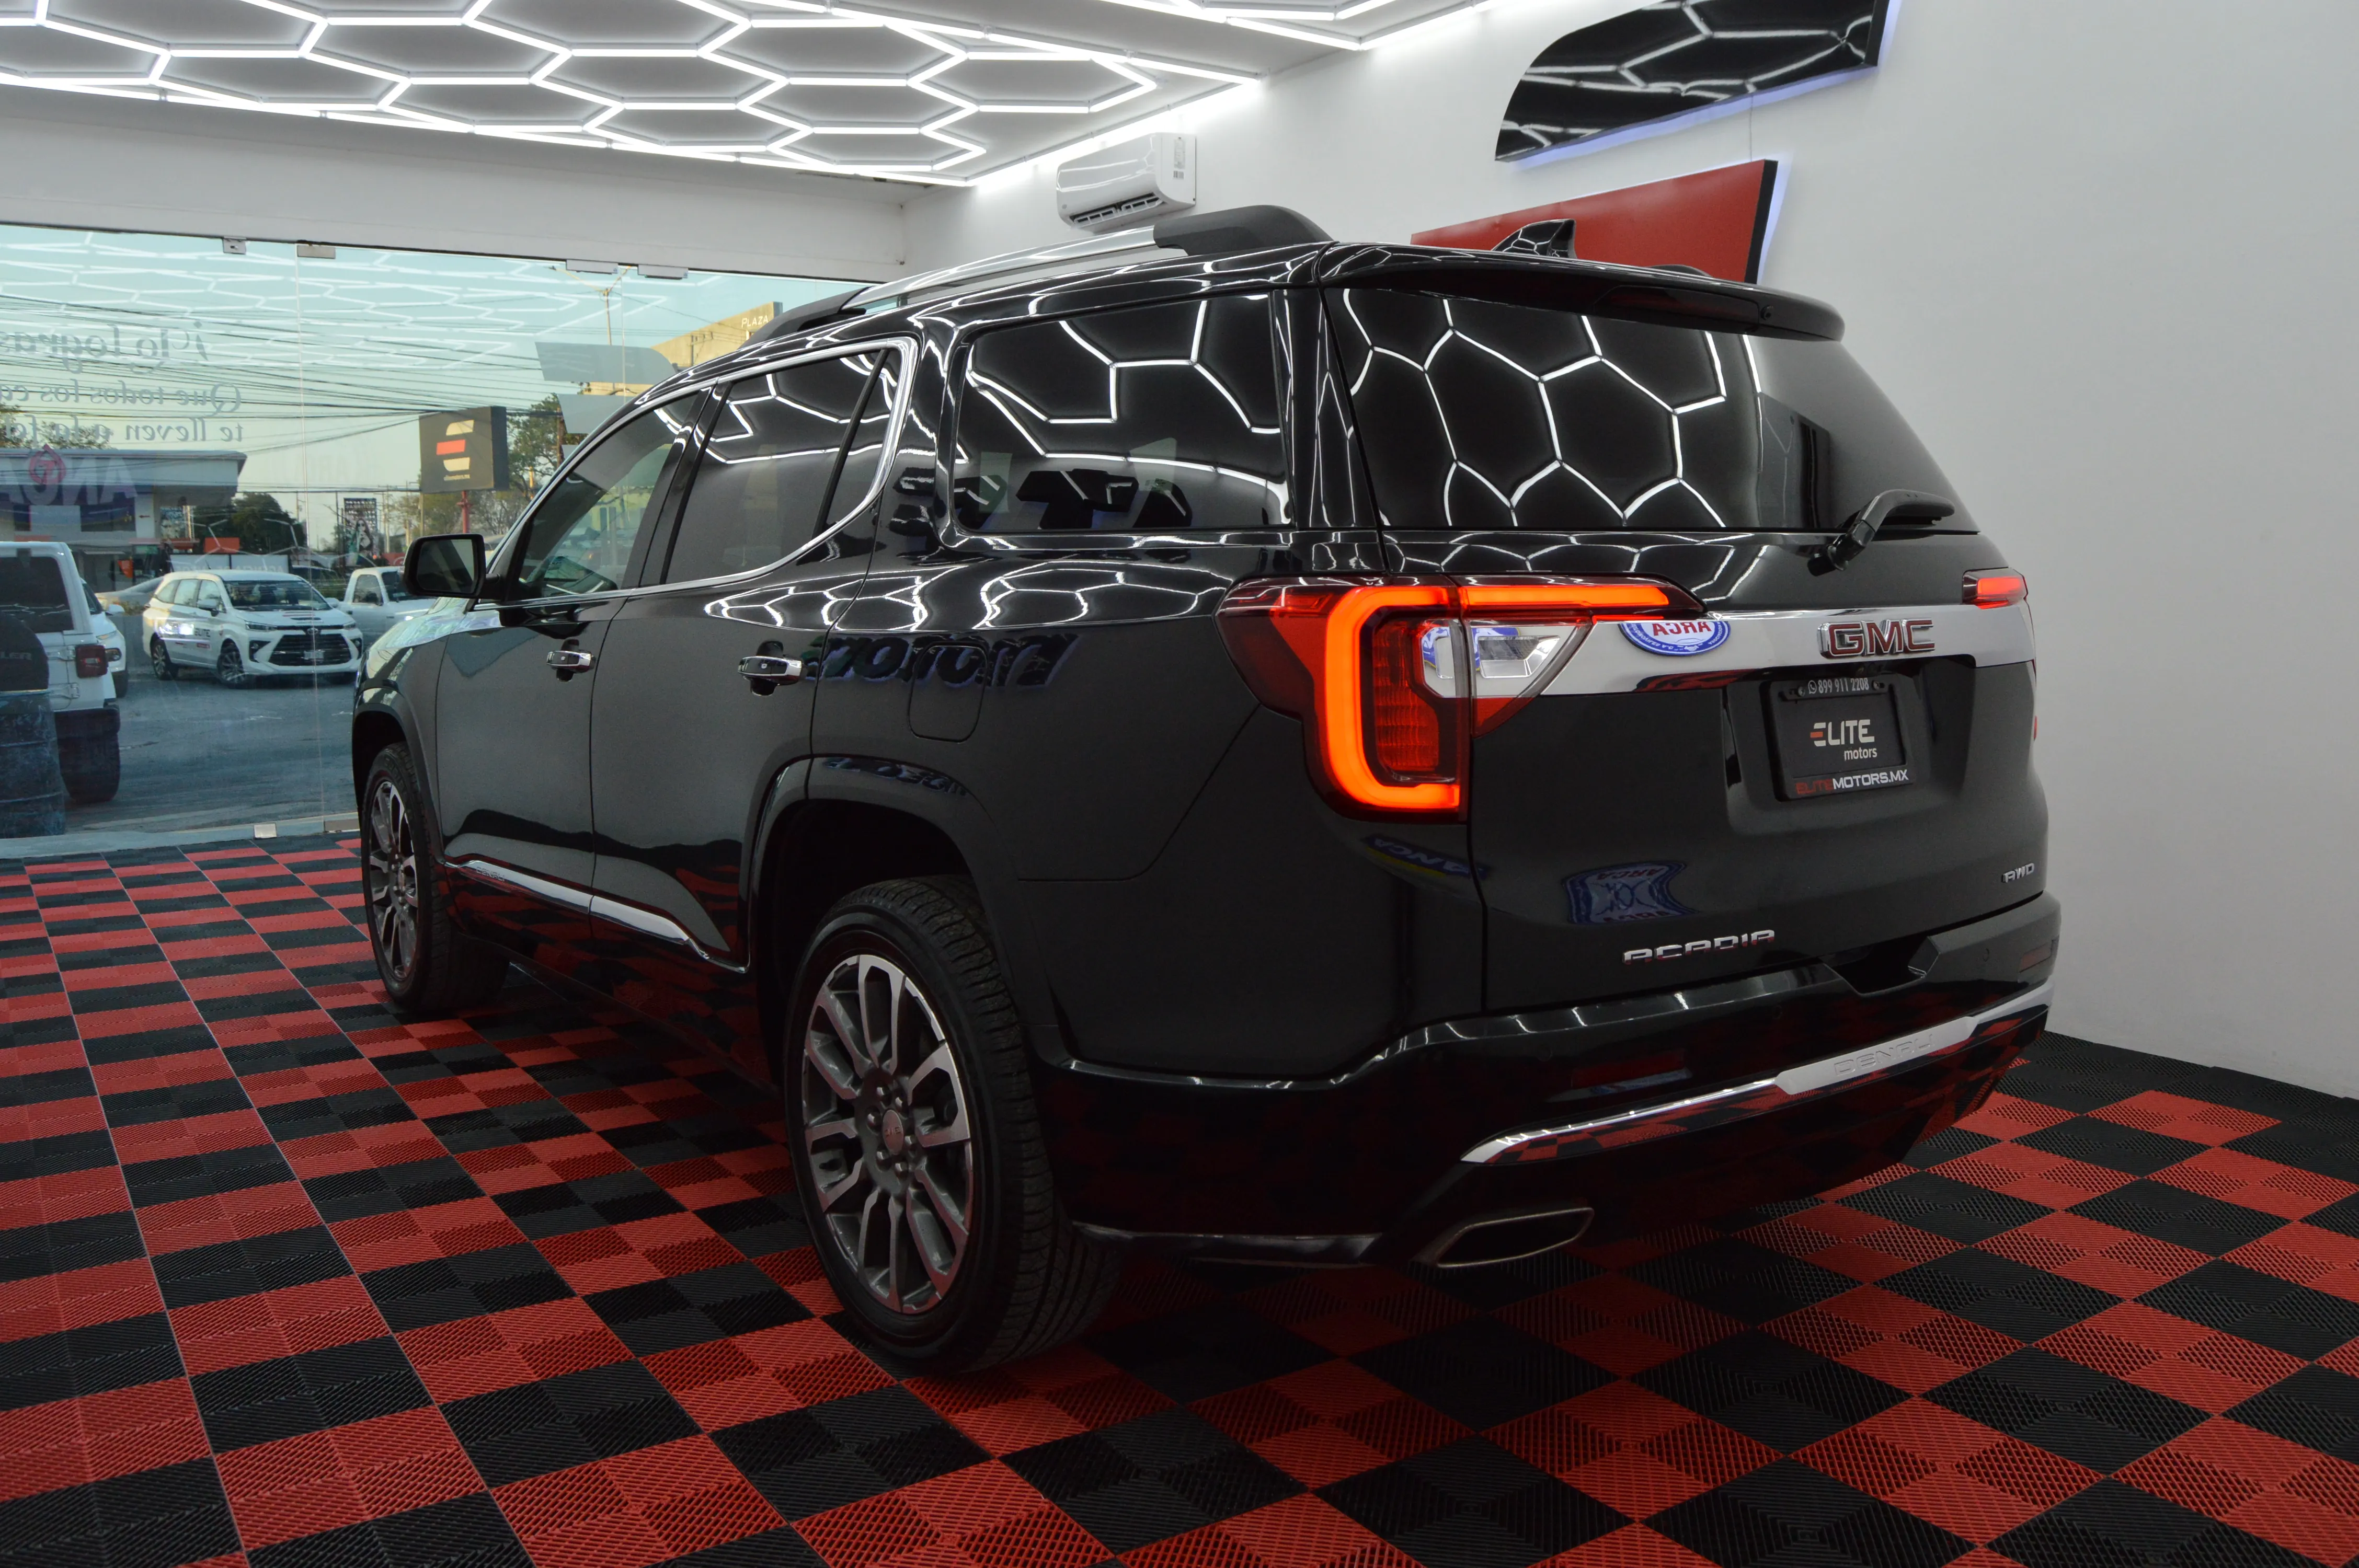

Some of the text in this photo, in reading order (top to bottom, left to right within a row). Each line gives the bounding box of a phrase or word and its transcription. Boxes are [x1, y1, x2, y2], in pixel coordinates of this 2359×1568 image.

[741, 315, 769, 328] PLAZA
[1818, 618, 1936, 659] GMC
[1818, 677, 1870, 694] 899 911 2208
[1810, 719, 1875, 747] ELITE
[1844, 747, 1878, 762] motors
[2001, 862, 2035, 883] AWD
[1623, 929, 1775, 965] ACADIA
[1834, 1034, 1936, 1077] DENALI
